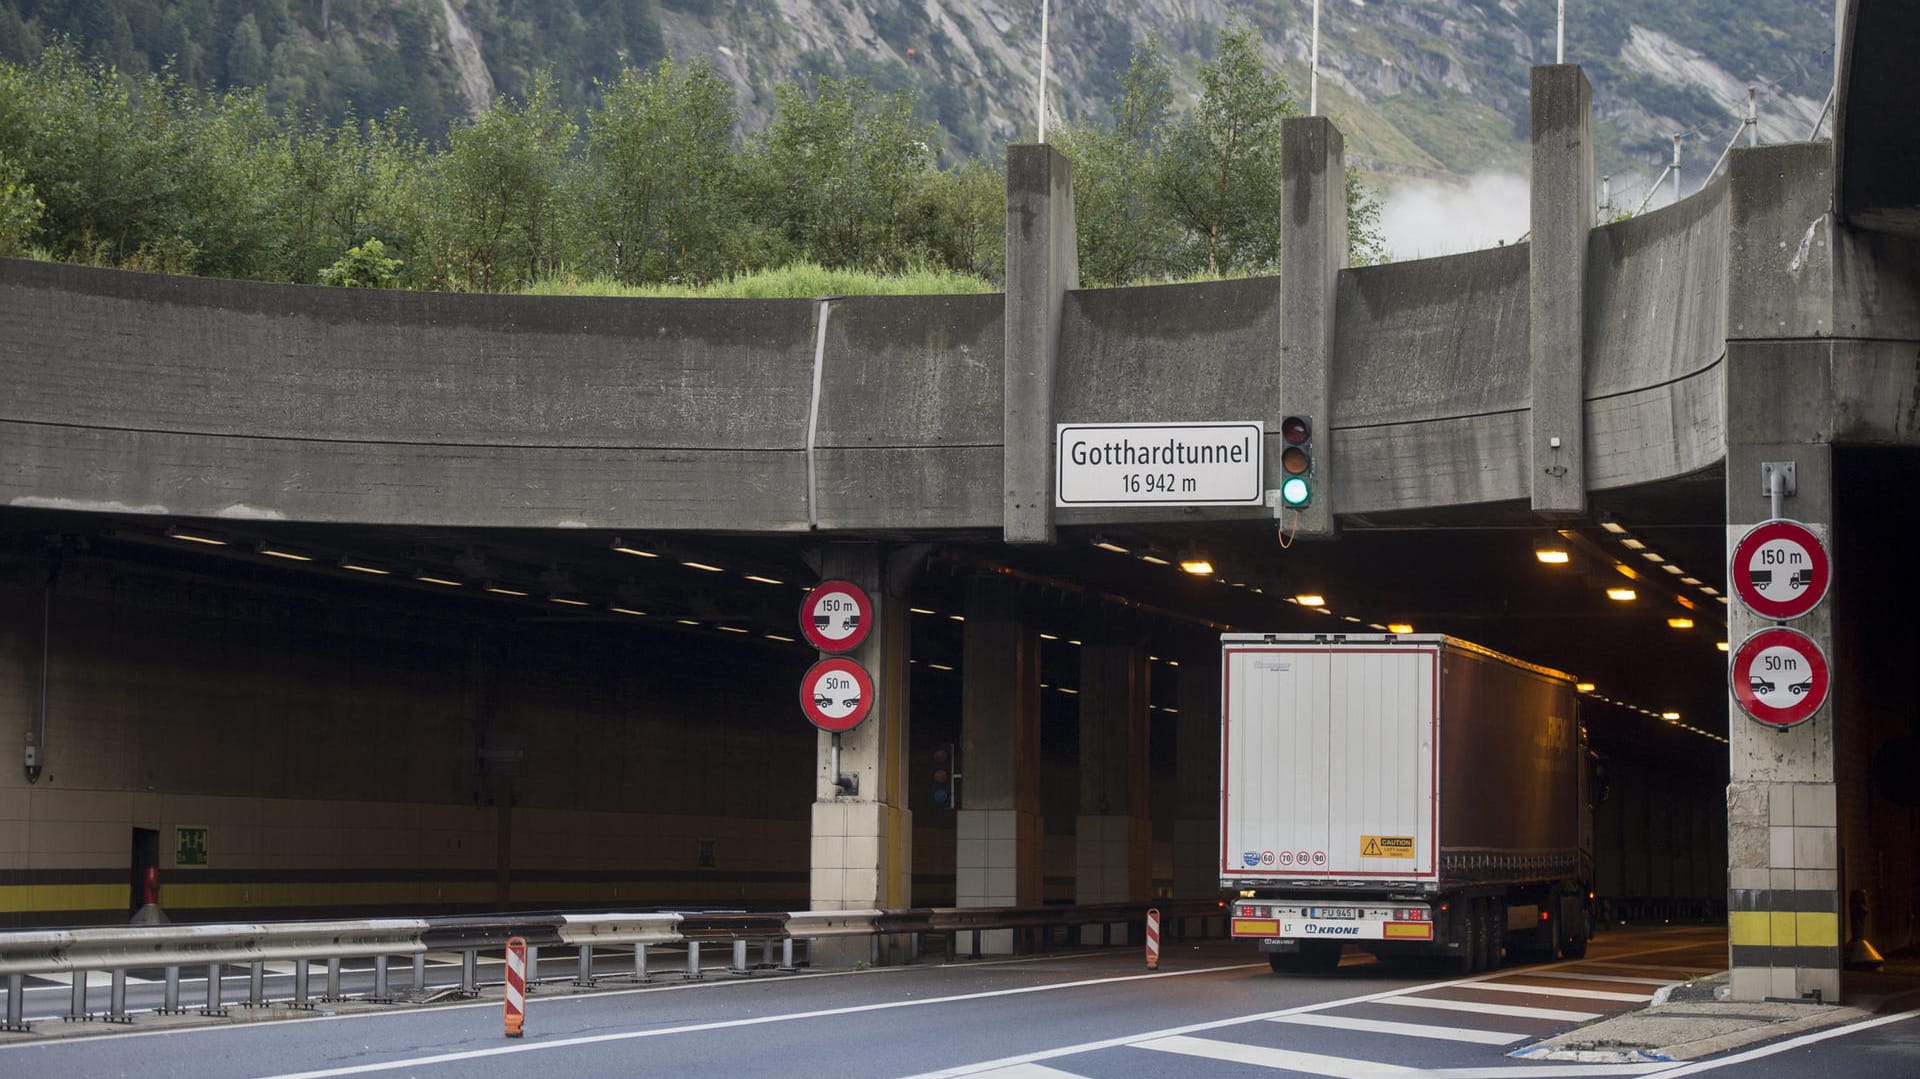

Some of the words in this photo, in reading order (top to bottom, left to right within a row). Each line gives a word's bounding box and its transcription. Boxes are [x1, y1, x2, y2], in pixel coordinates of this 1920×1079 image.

[1071, 436, 1249, 466] Gotthardtunnel
[1122, 473, 1140, 493] 16
[1145, 473, 1175, 492] 942
[1182, 477, 1196, 492] m
[1761, 549, 1785, 565] 150
[1789, 552, 1802, 564] m
[823, 599, 840, 612] 150
[843, 602, 853, 611] m
[1765, 655, 1781, 671] 50
[1784, 658, 1797, 670] m
[826, 677, 839, 690] 50
[840, 680, 850, 689] m
[1263, 854, 1273, 862] 60
[1282, 854, 1291, 862] 70
[1299, 854, 1308, 862] 80
[1314, 854, 1324, 862] 90
[1336, 908, 1352, 917] 945
[1284, 923, 1292, 932] LT
[1318, 926, 1360, 935] KRONE
